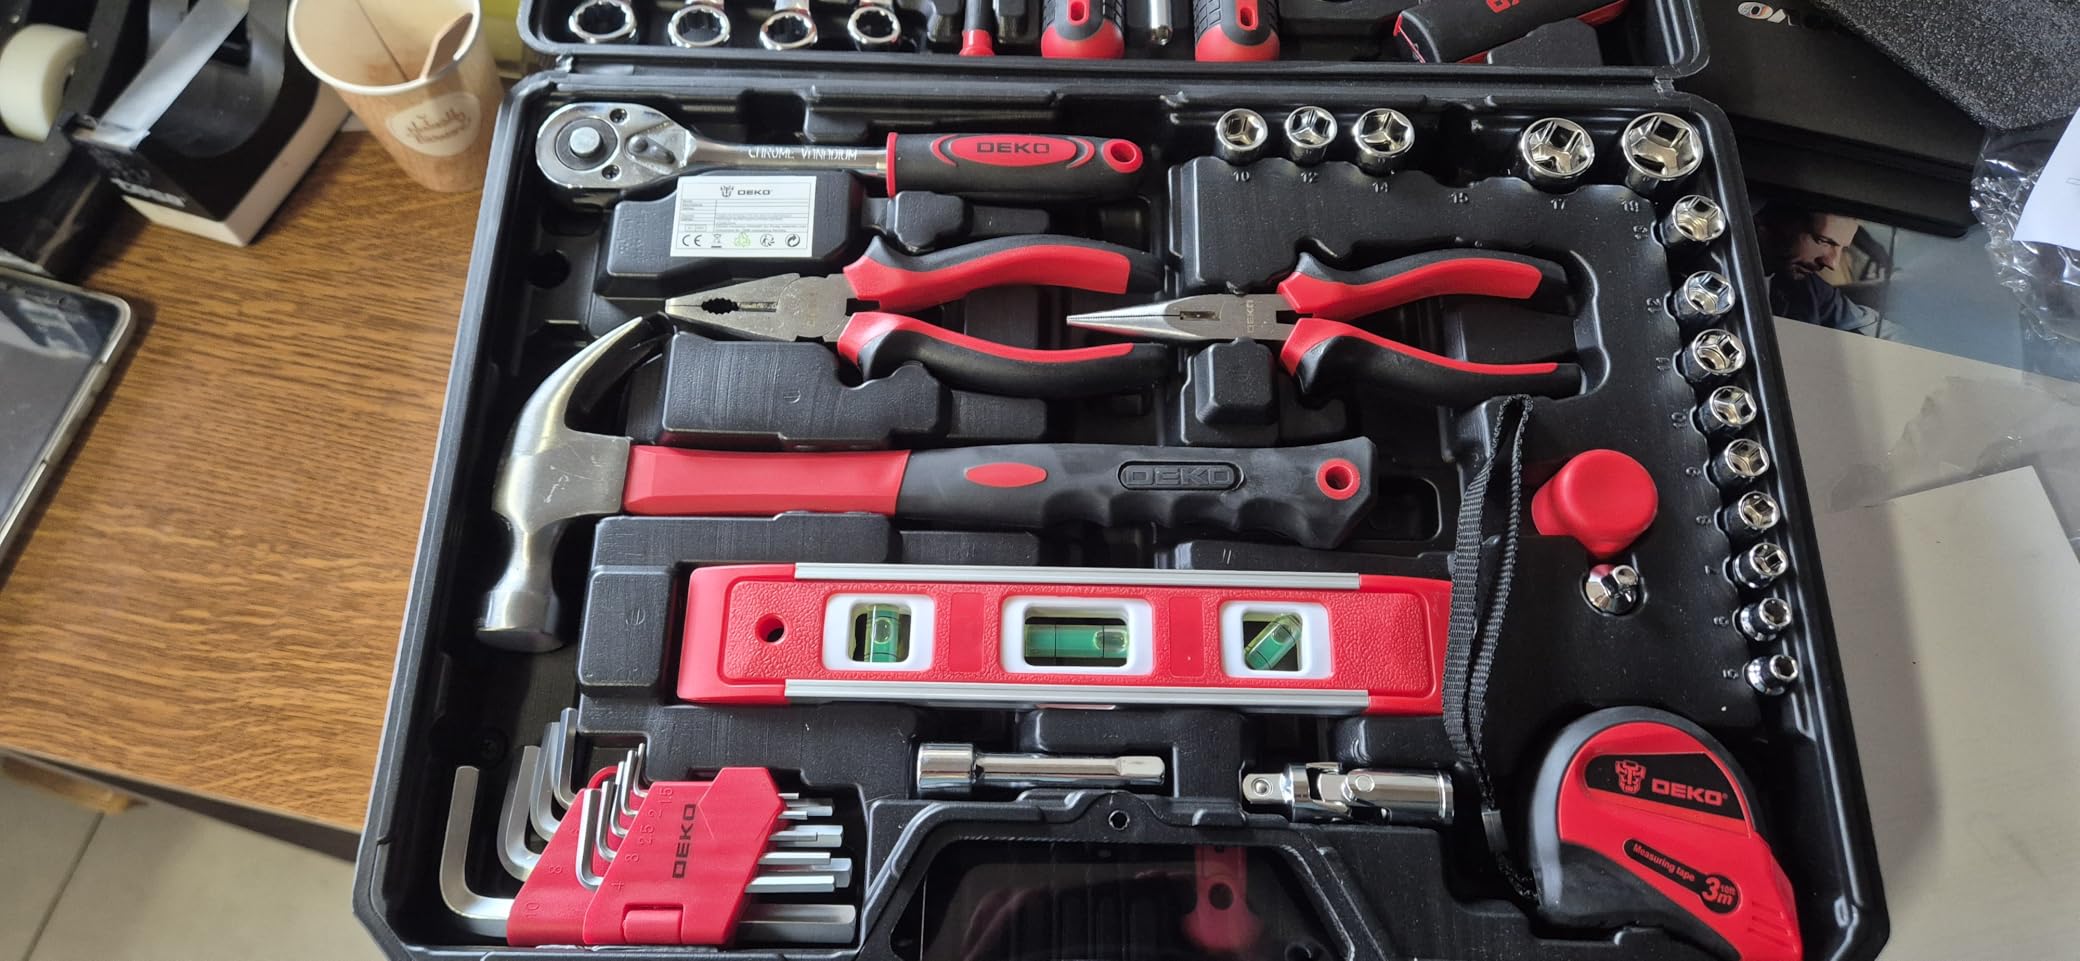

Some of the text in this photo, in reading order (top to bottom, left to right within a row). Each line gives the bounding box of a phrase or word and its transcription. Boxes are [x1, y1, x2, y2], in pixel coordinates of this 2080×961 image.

[976, 142, 1050, 154] DEKO
[1232, 170, 1250, 182] 10
[1372, 181, 1389, 193] 14
[1550, 198, 1566, 211] 17
[1125, 465, 1231, 485] DEKO
[672, 803, 697, 879] DEKO
[1633, 842, 1696, 882] Measuring tape
